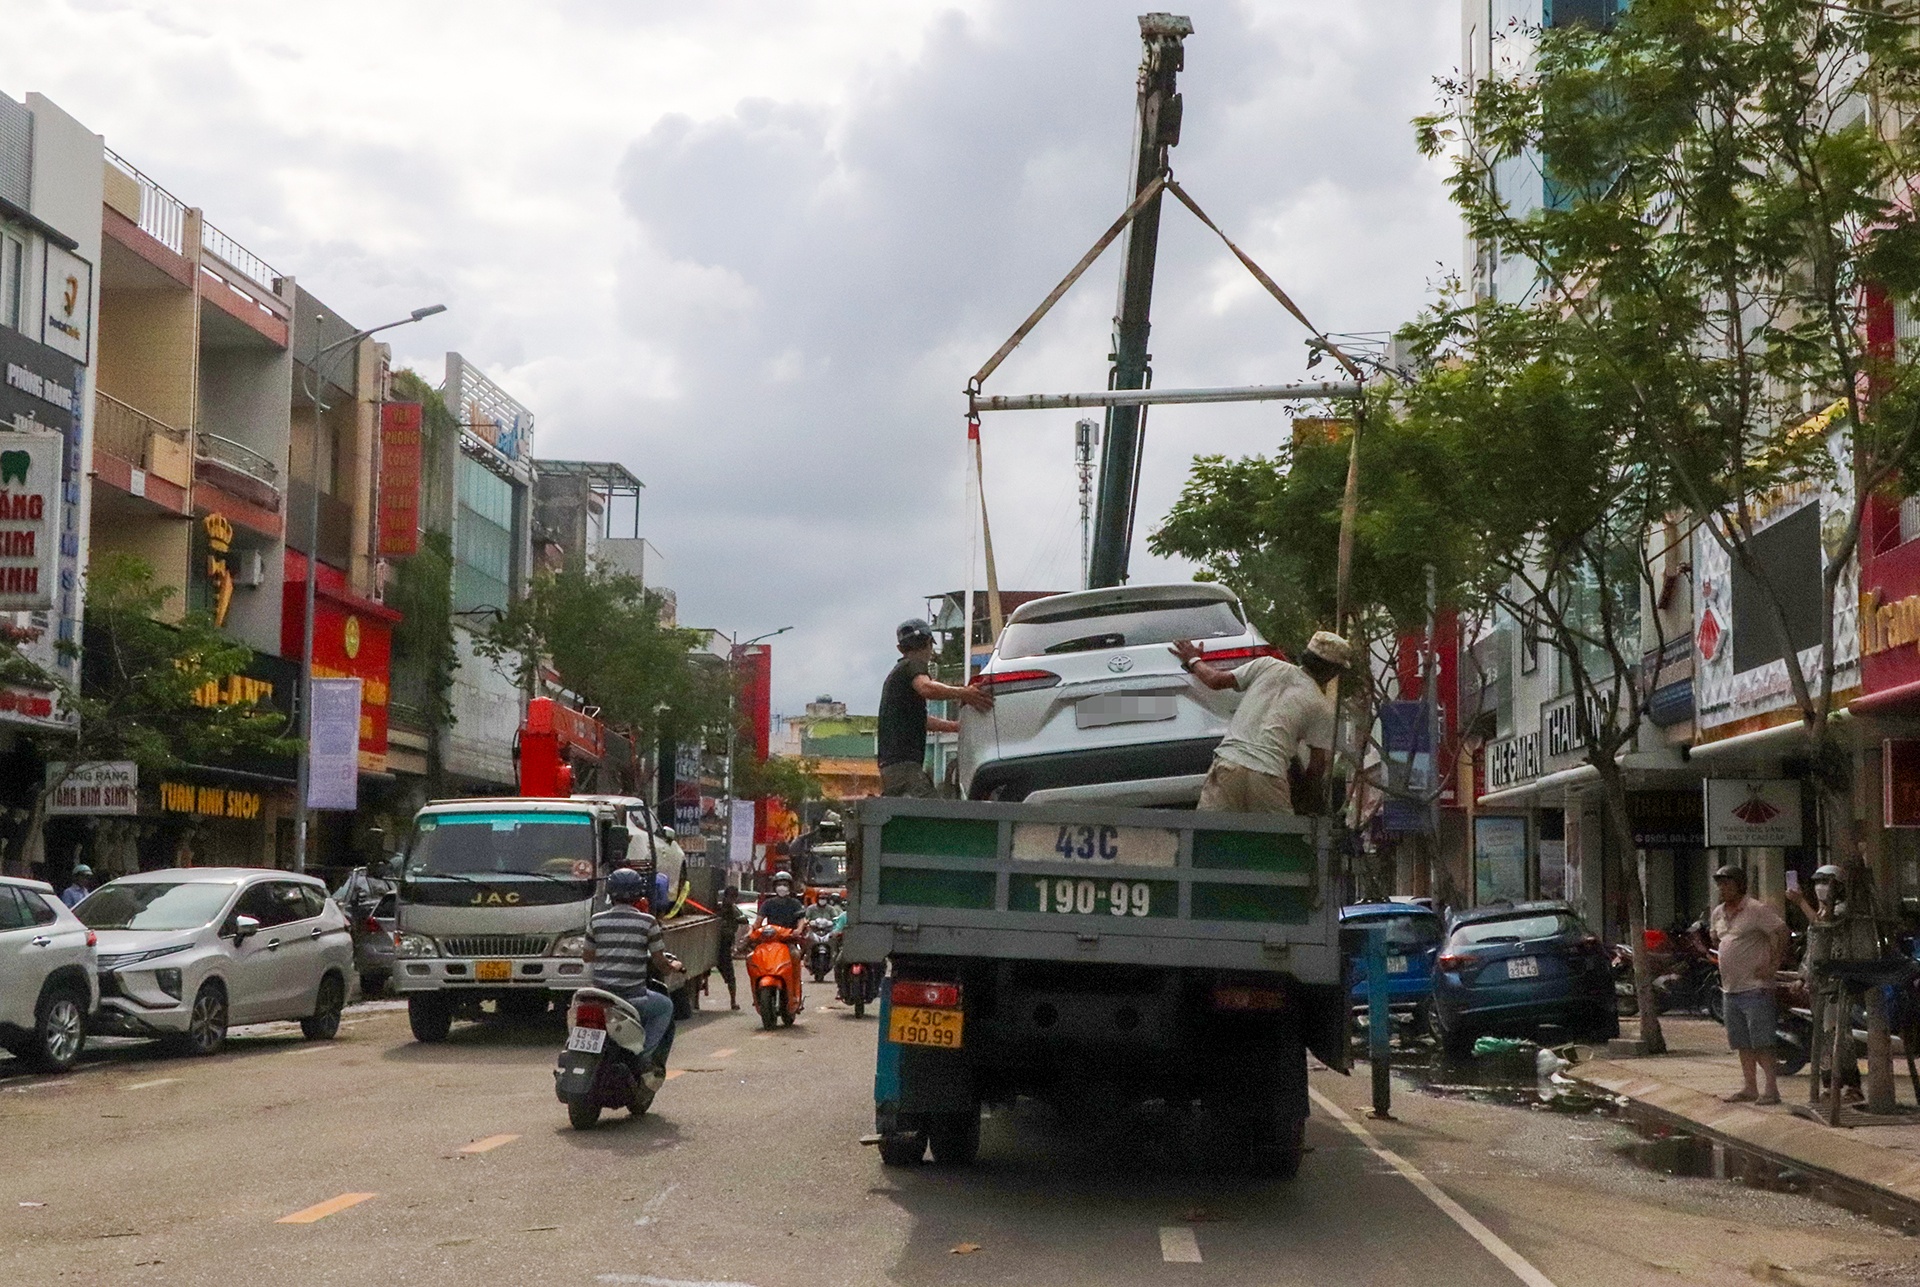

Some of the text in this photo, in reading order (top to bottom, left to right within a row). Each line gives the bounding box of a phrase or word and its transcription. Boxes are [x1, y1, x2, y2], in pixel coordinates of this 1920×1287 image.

[226, 790, 260, 819] SHOP
[1055, 825, 1118, 860] 43C
[470, 892, 520, 904] JAC
[1035, 878, 1150, 918] 190-99
[911, 1009, 942, 1027] 43C
[899, 1025, 954, 1046] 190.99
